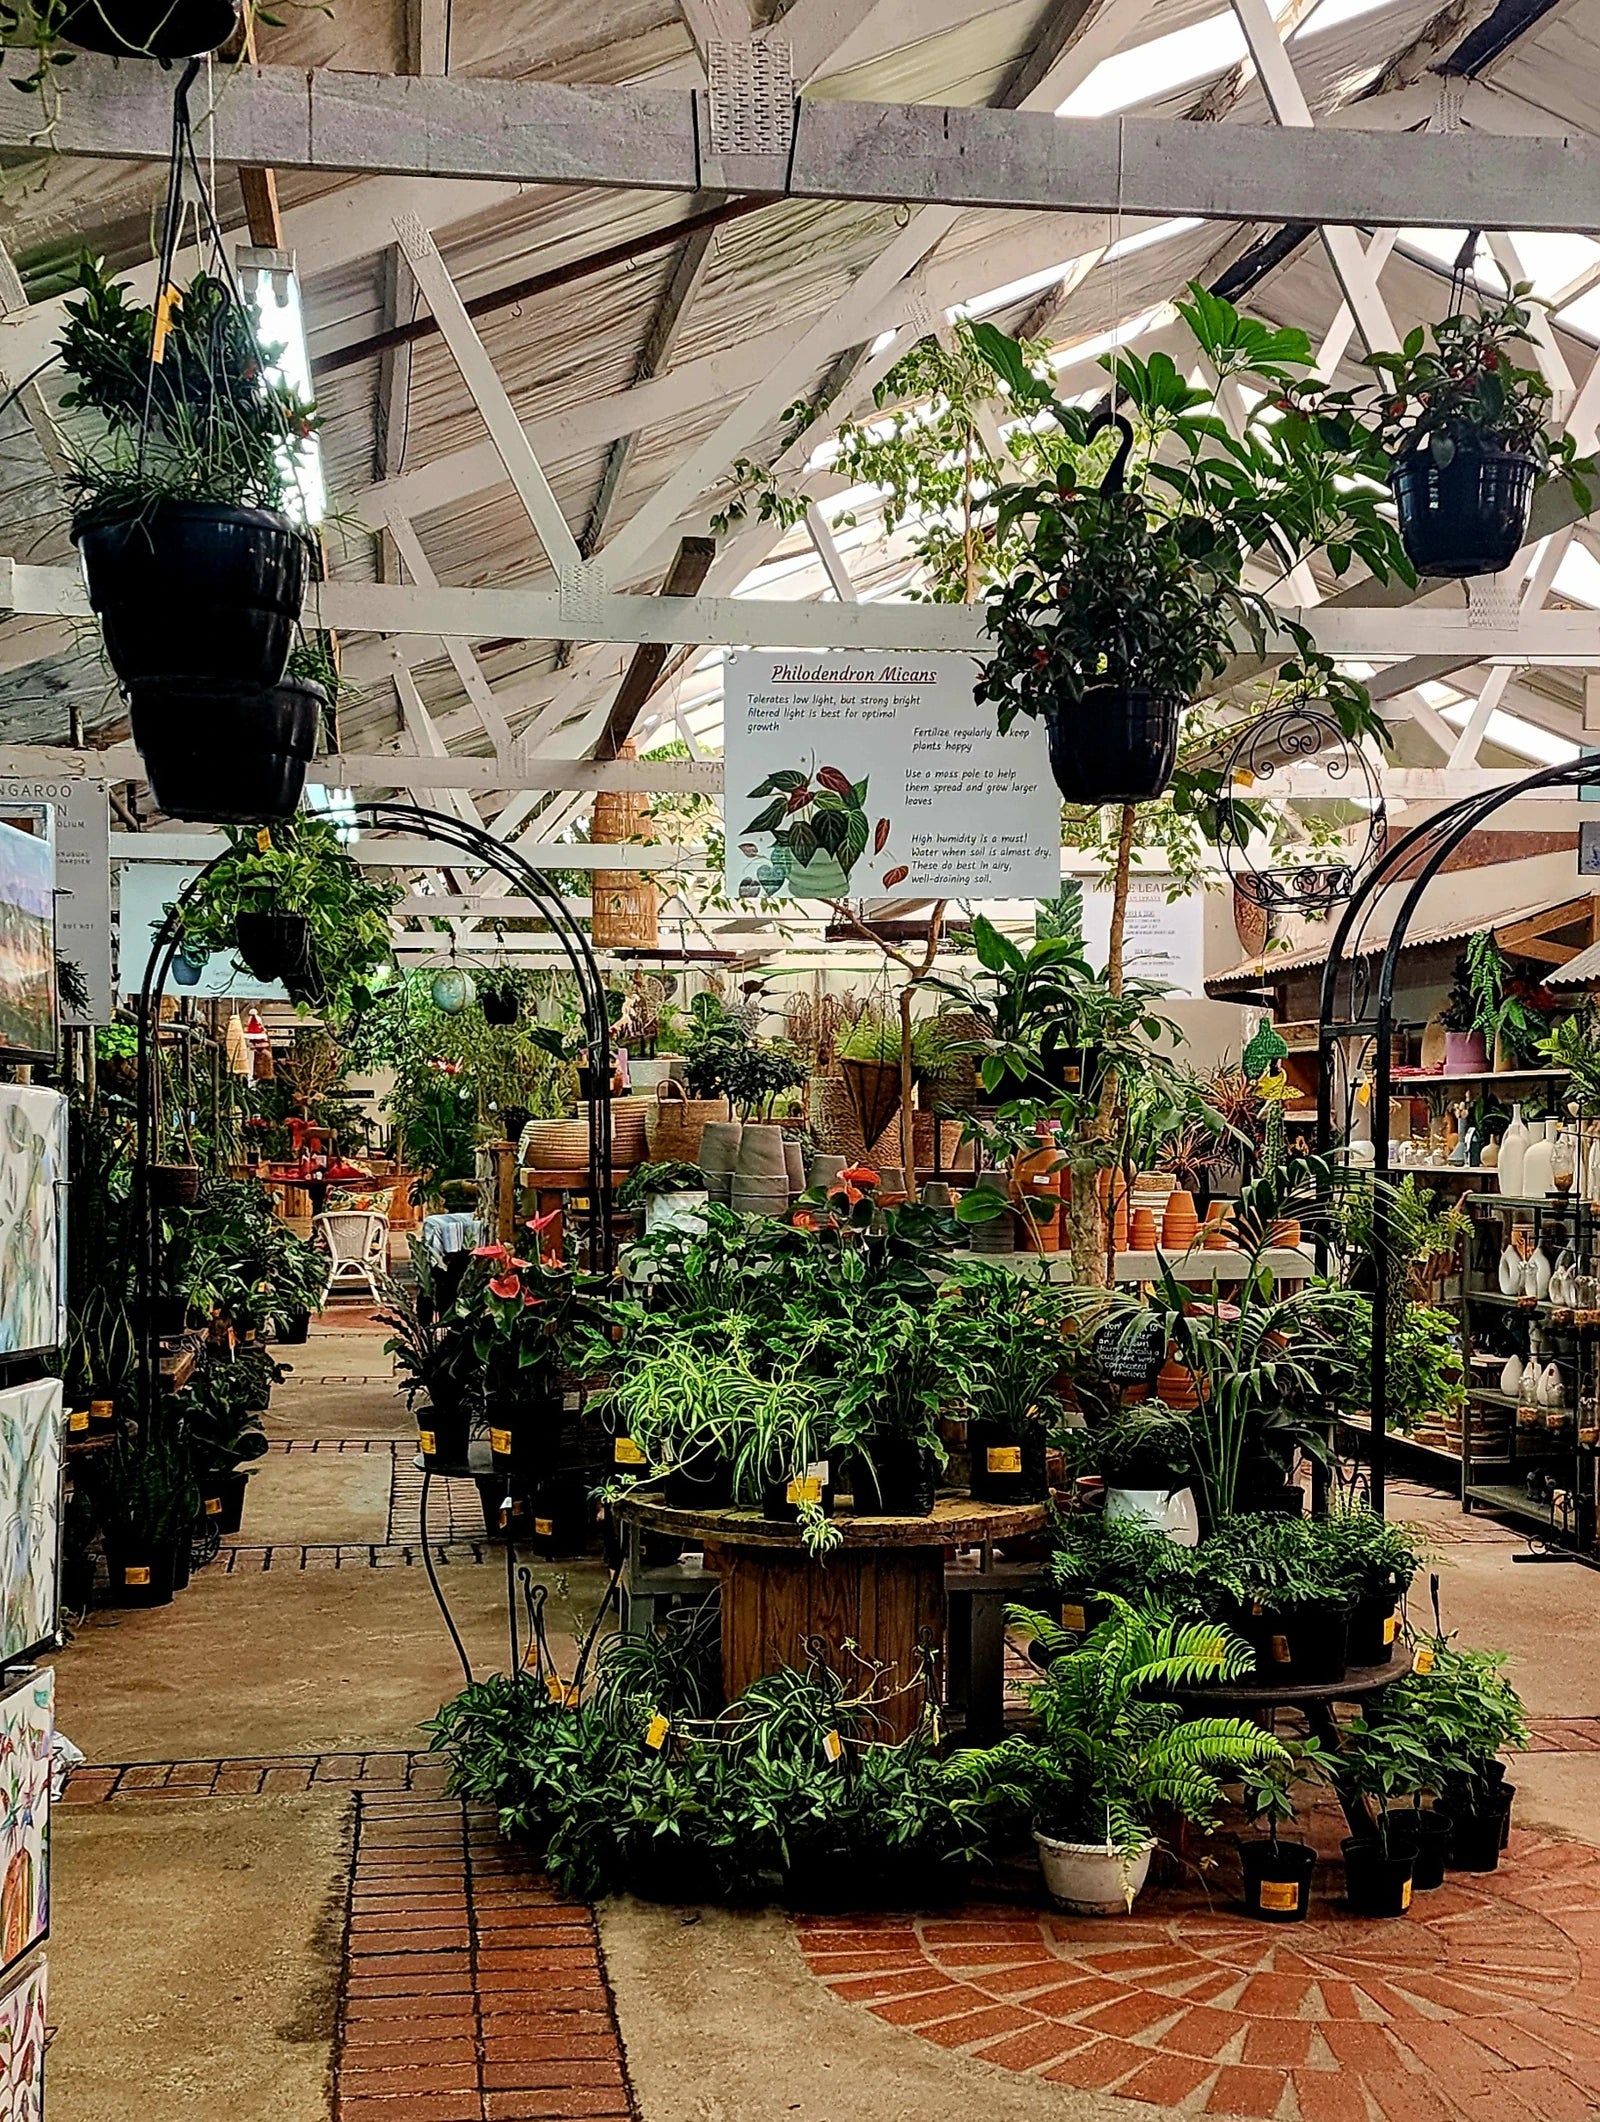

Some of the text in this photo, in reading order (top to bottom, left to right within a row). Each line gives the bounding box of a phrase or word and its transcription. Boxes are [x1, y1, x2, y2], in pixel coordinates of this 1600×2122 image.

[771, 664, 938, 682] Philodendron Micans
[748, 693, 921, 708] Tolerates low light, but strong bright
[747, 707, 896, 721] filtered light is best for optimal
[747, 721, 780, 734] growth
[913, 727, 950, 738] Fertilize
[953, 727, 993, 740] regularly
[1009, 727, 1030, 740] keep
[912, 740, 973, 753] plants happy
[905, 767, 1017, 781] Use a moss pole to help
[905, 781, 1038, 795] them spread and grow larger
[904, 795, 933, 806] leaves
[911, 832, 1028, 846] High humidity is a must!
[911, 846, 1052, 860] Water when soil is almost dry.
[911, 860, 1012, 873] These do best in airy,
[911, 873, 992, 886] well-draining soil.
